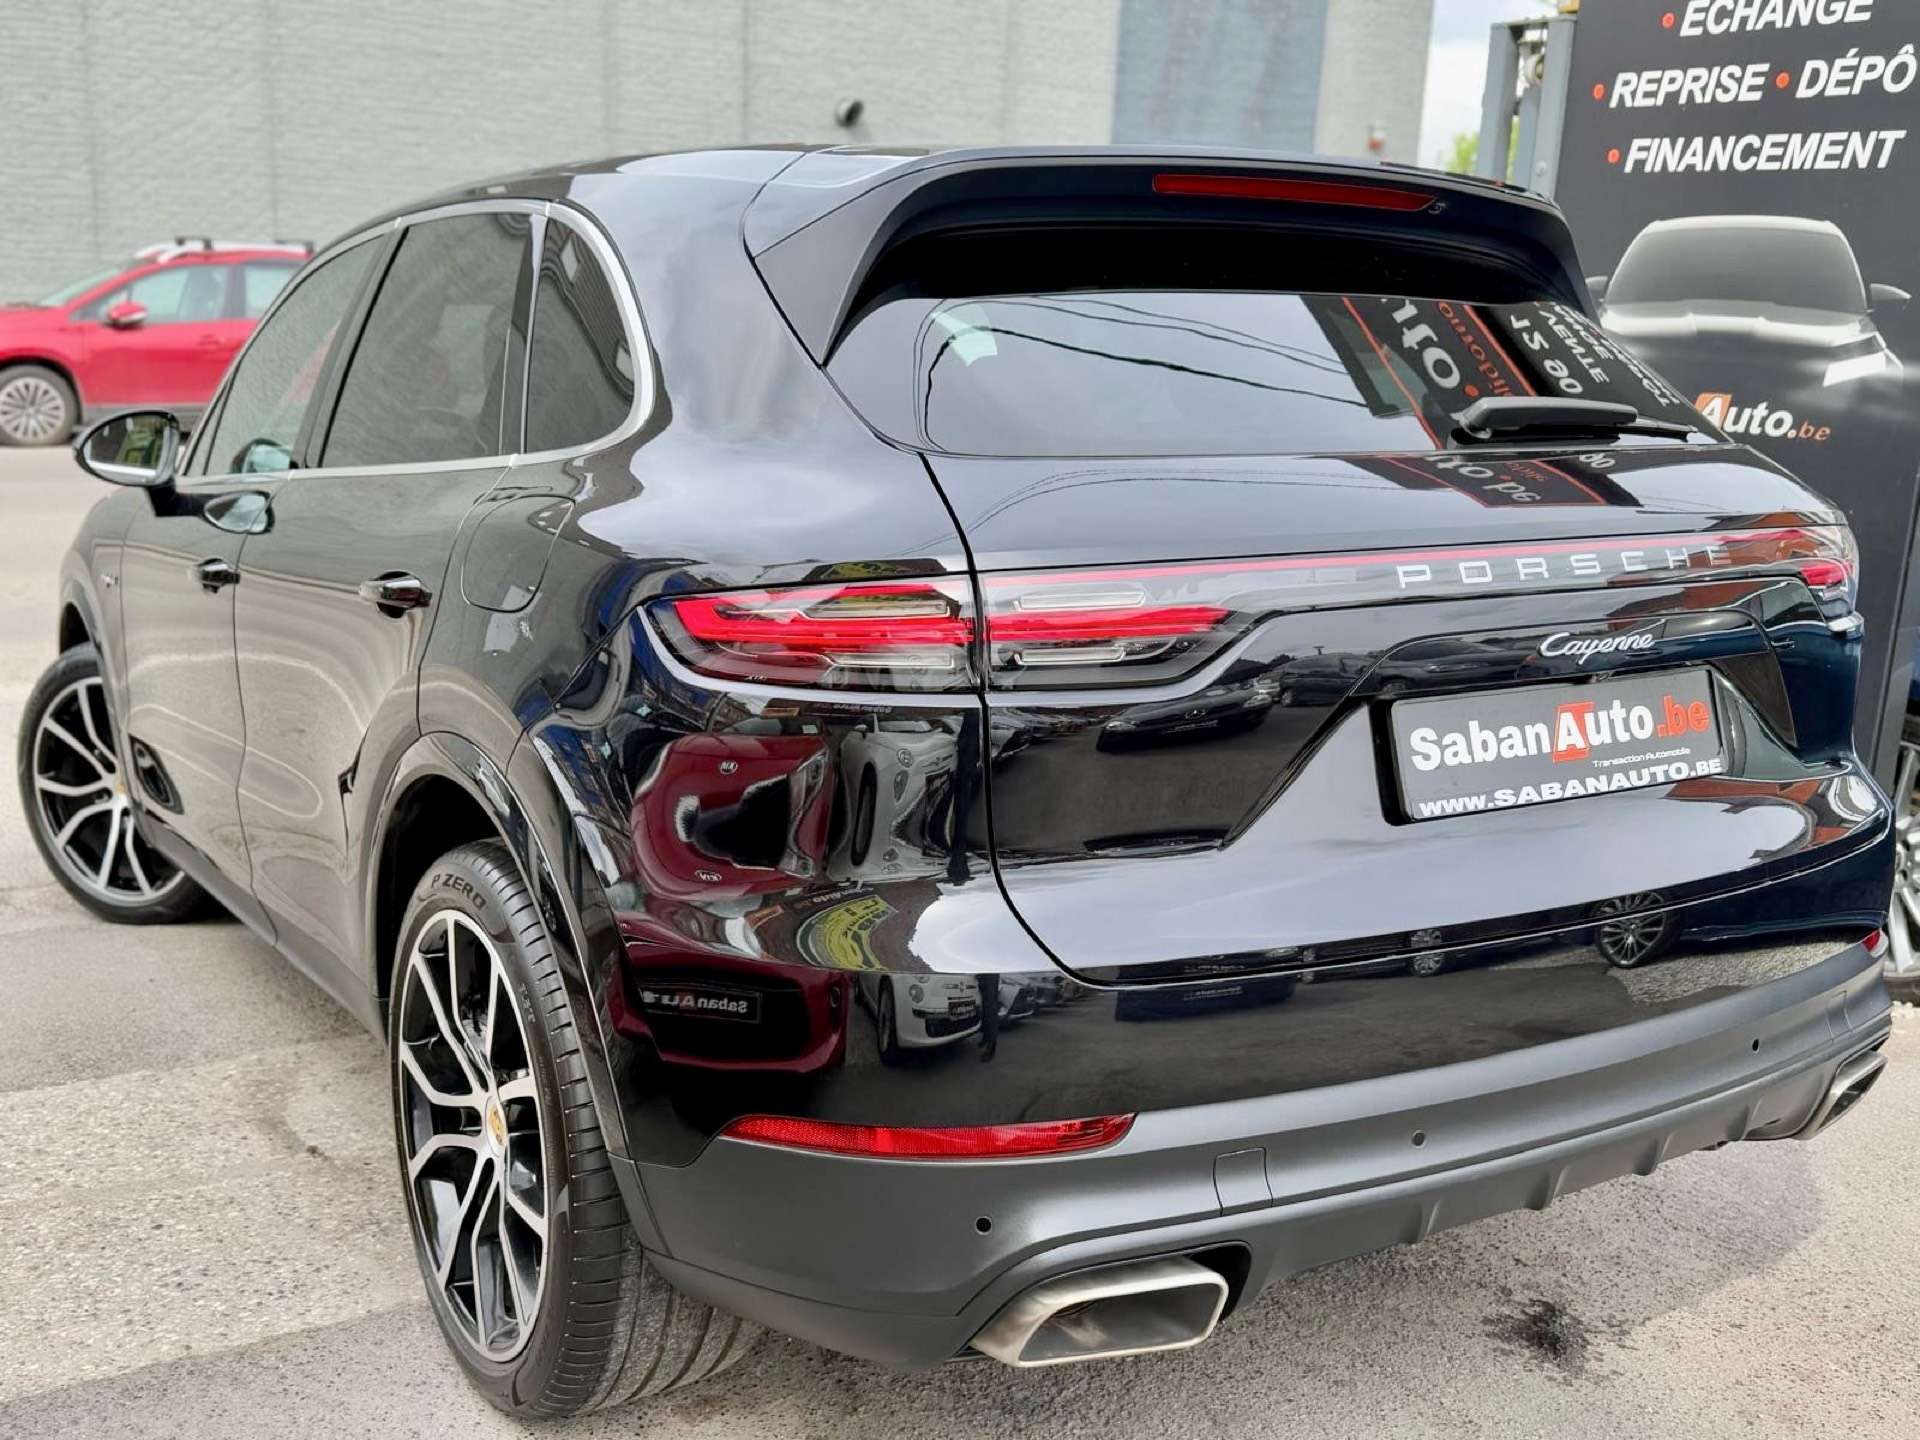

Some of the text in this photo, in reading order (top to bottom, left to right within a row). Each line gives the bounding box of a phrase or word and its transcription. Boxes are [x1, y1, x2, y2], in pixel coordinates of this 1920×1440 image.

[1608, 43, 1918, 108] REPRISE DÉPÔ
[1623, 129, 1907, 173] FINANCEMENT
[1396, 545, 1732, 588] PORSCHE
[1540, 632, 1655, 666] Cayenne
[1410, 695, 1710, 772] SabanAuto.be
[1592, 747, 1691, 768] Transaction Automobile
[431, 873, 487, 910] P ZERO
